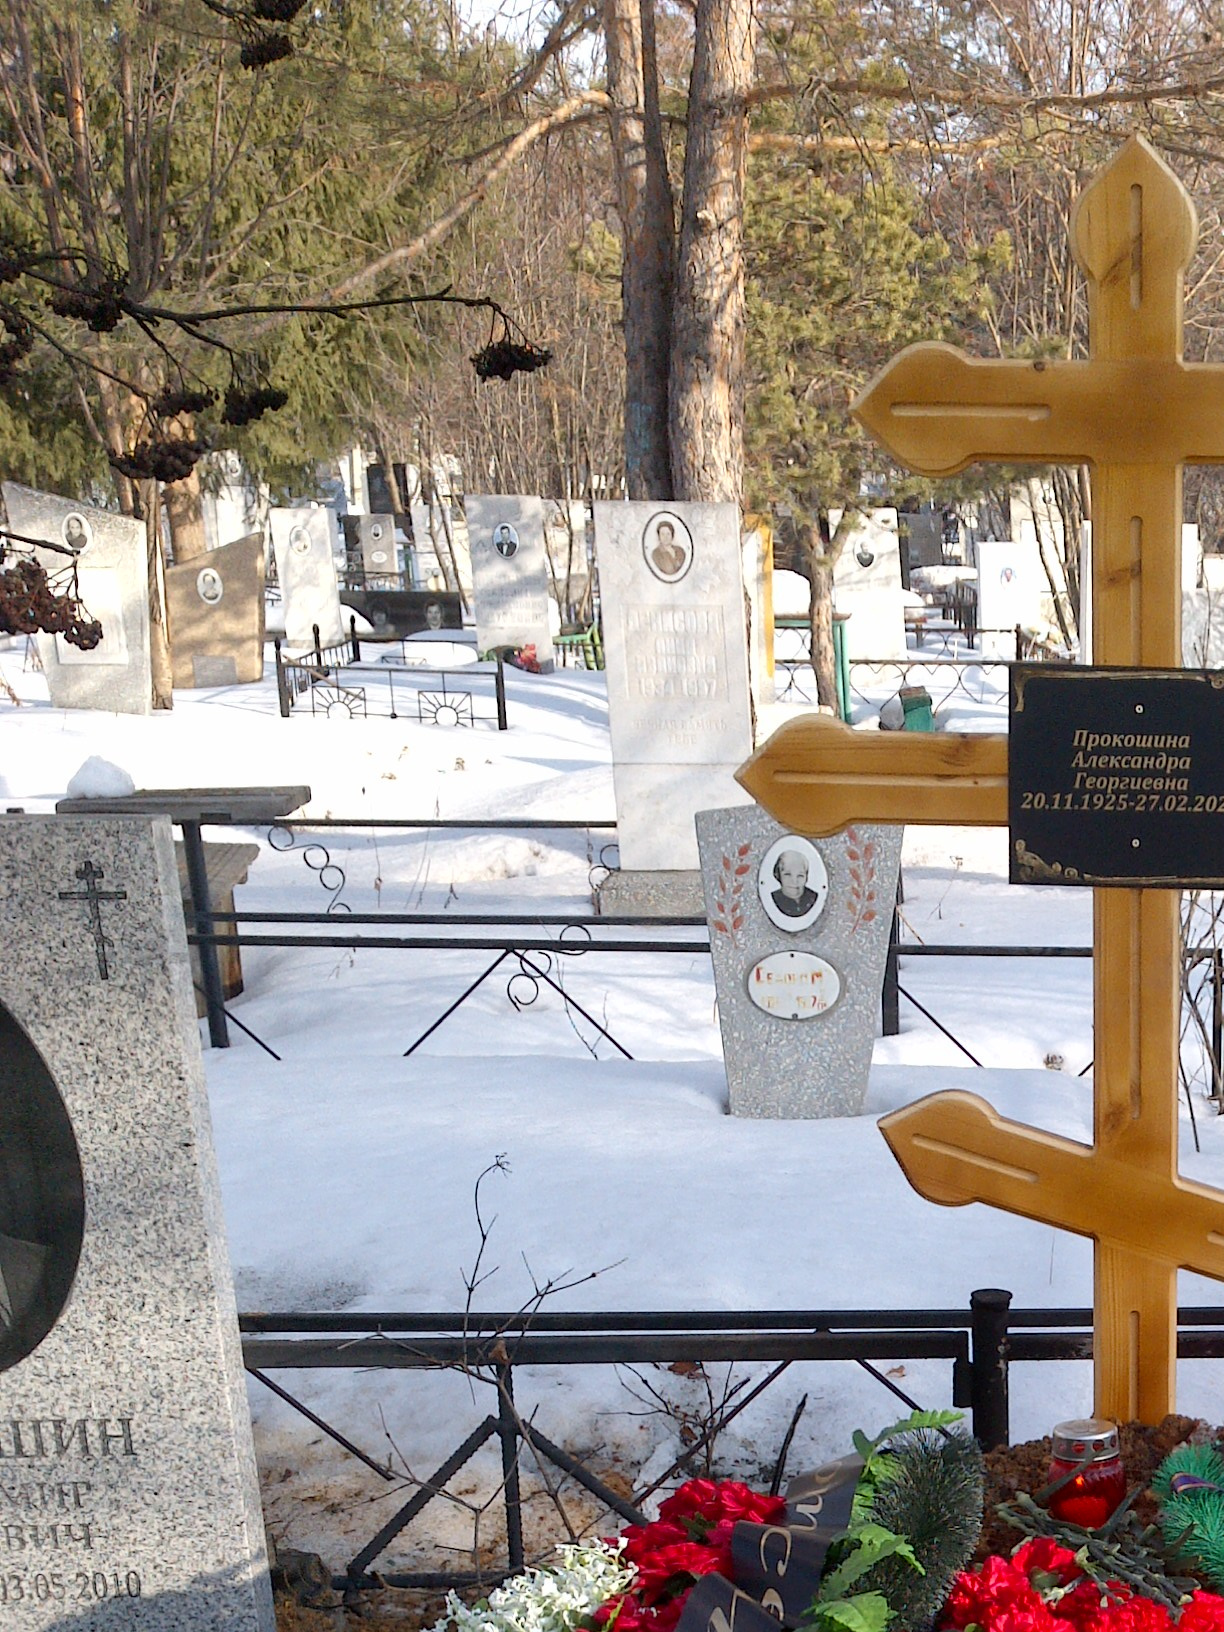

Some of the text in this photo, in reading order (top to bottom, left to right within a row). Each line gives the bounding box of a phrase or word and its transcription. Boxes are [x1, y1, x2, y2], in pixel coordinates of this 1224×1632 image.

[1072, 729, 1191, 751] Прокошина
[1071, 752, 1192, 773] Александра
[1073, 772, 1189, 794] Георгиевна
